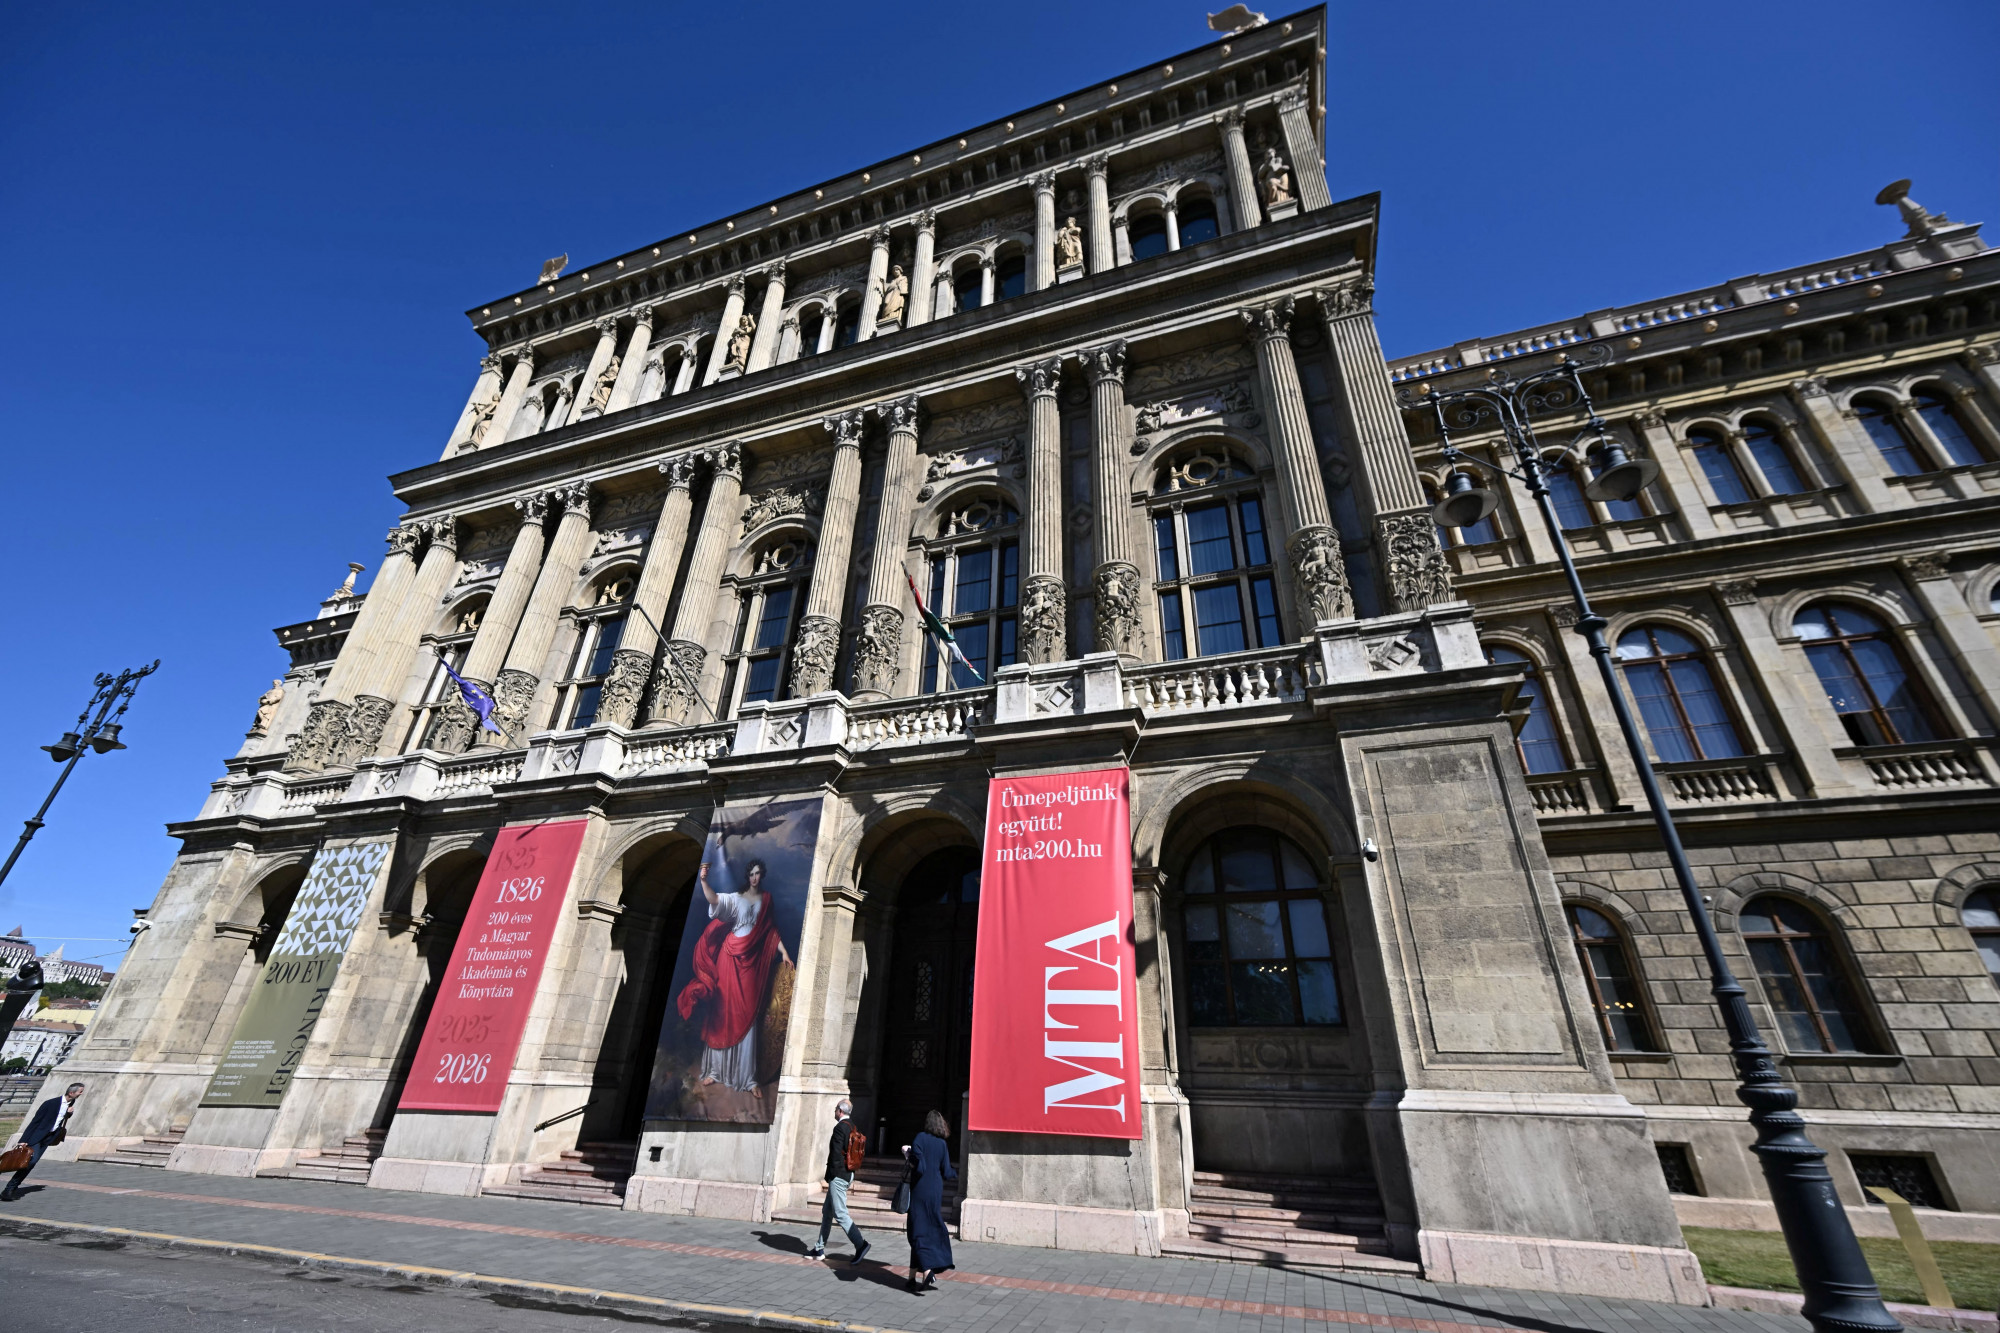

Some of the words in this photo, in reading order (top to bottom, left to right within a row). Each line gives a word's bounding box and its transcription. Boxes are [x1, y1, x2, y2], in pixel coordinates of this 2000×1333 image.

[1001, 783, 1118, 808] Ünnepeljünk
[998, 812, 1063, 838] együtt!
[995, 838, 1103, 862] mta200.hu
[495, 876, 545, 904] 1826
[487, 911, 509, 926] 200
[510, 911, 533, 925] éves
[480, 933, 487, 944] a
[489, 928, 531, 945] Magyar
[466, 947, 533, 963] Tudományos
[263, 961, 300, 984] 200
[299, 955, 330, 983] ÉV
[457, 965, 513, 980] Akadémia
[515, 965, 528, 979] és
[458, 983, 514, 1001] Könyvtára
[1044, 910, 1126, 1123] MTA
[264, 987, 331, 1097] KINCSEI
[433, 1053, 492, 1084] 2026
